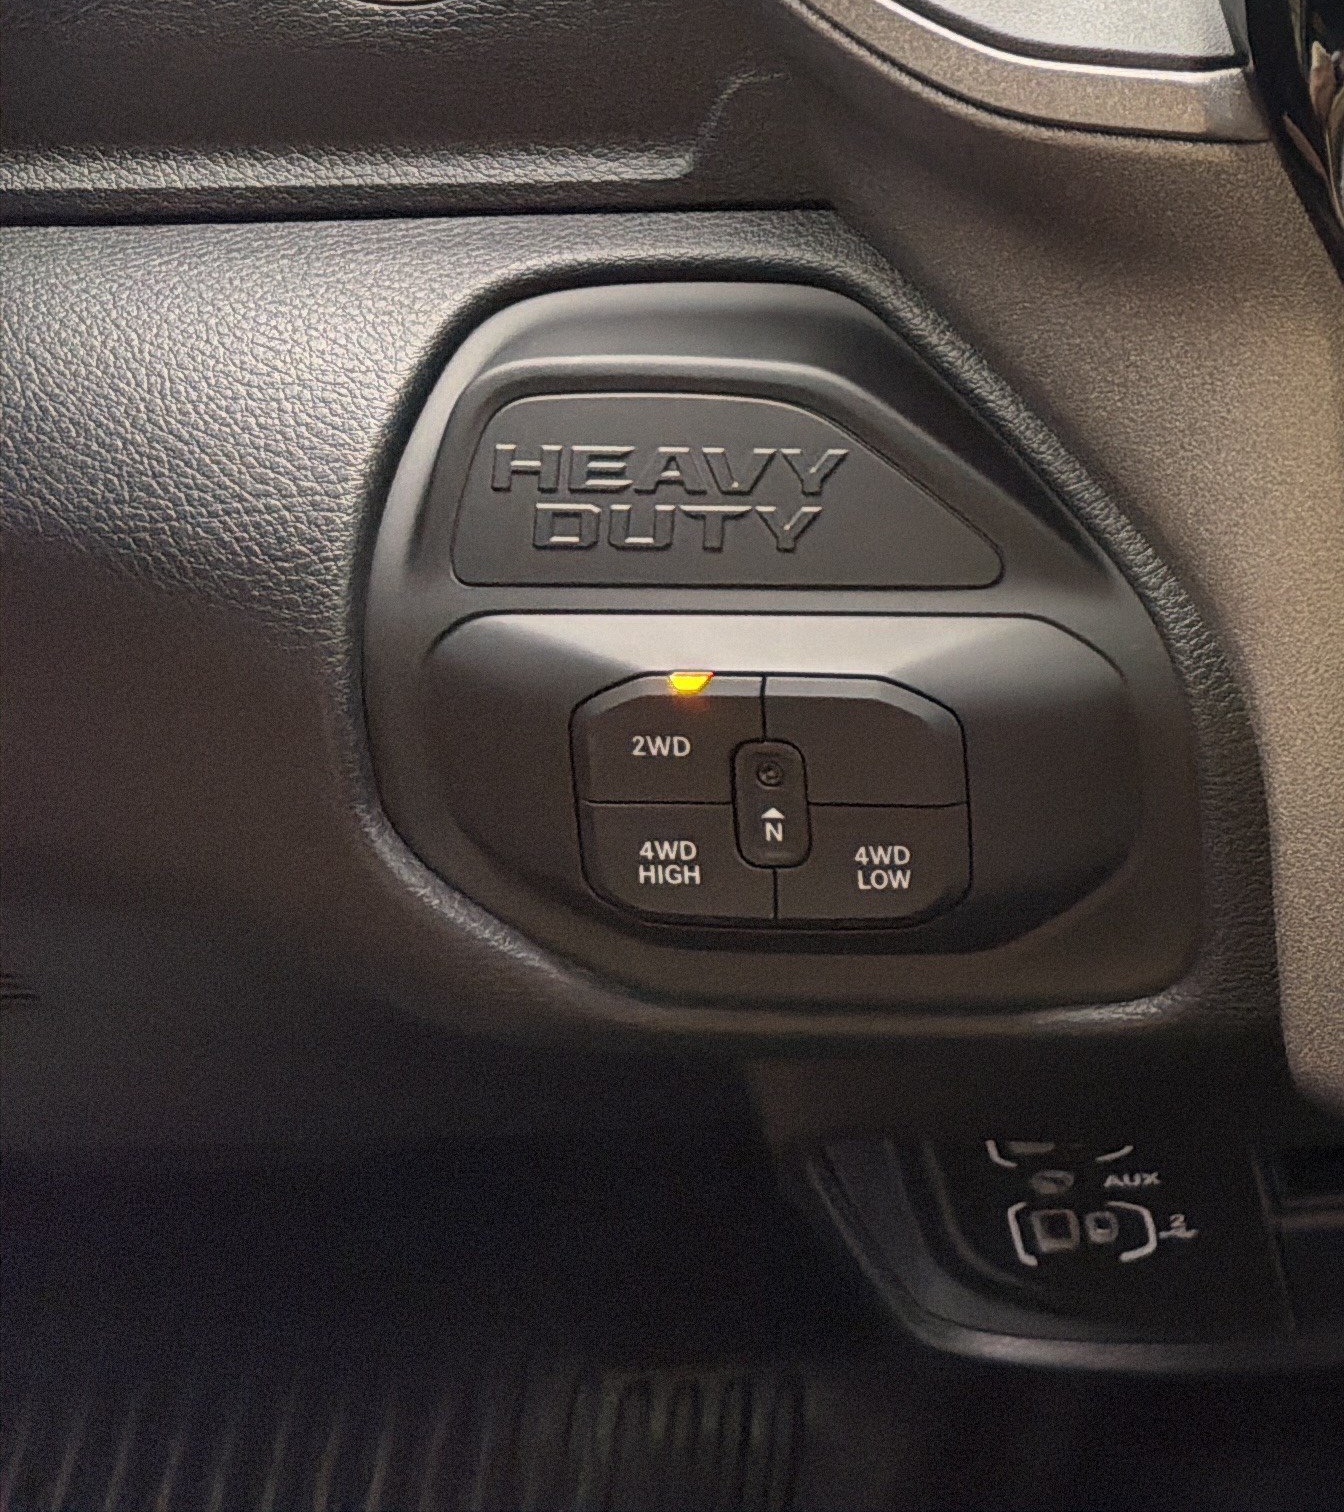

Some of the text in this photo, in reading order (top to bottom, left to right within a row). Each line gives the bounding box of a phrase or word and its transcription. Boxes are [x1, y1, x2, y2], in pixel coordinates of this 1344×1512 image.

[491, 444, 849, 494] HEAVY
[532, 502, 822, 551] DUTY
[632, 736, 691, 757] 2WD
[765, 822, 783, 842] N
[639, 840, 697, 861] 4WD
[854, 845, 910, 865] 4WD
[638, 865, 700, 885] HIGH
[857, 870, 911, 889] LOW
[1103, 1171, 1162, 1188] AUX
